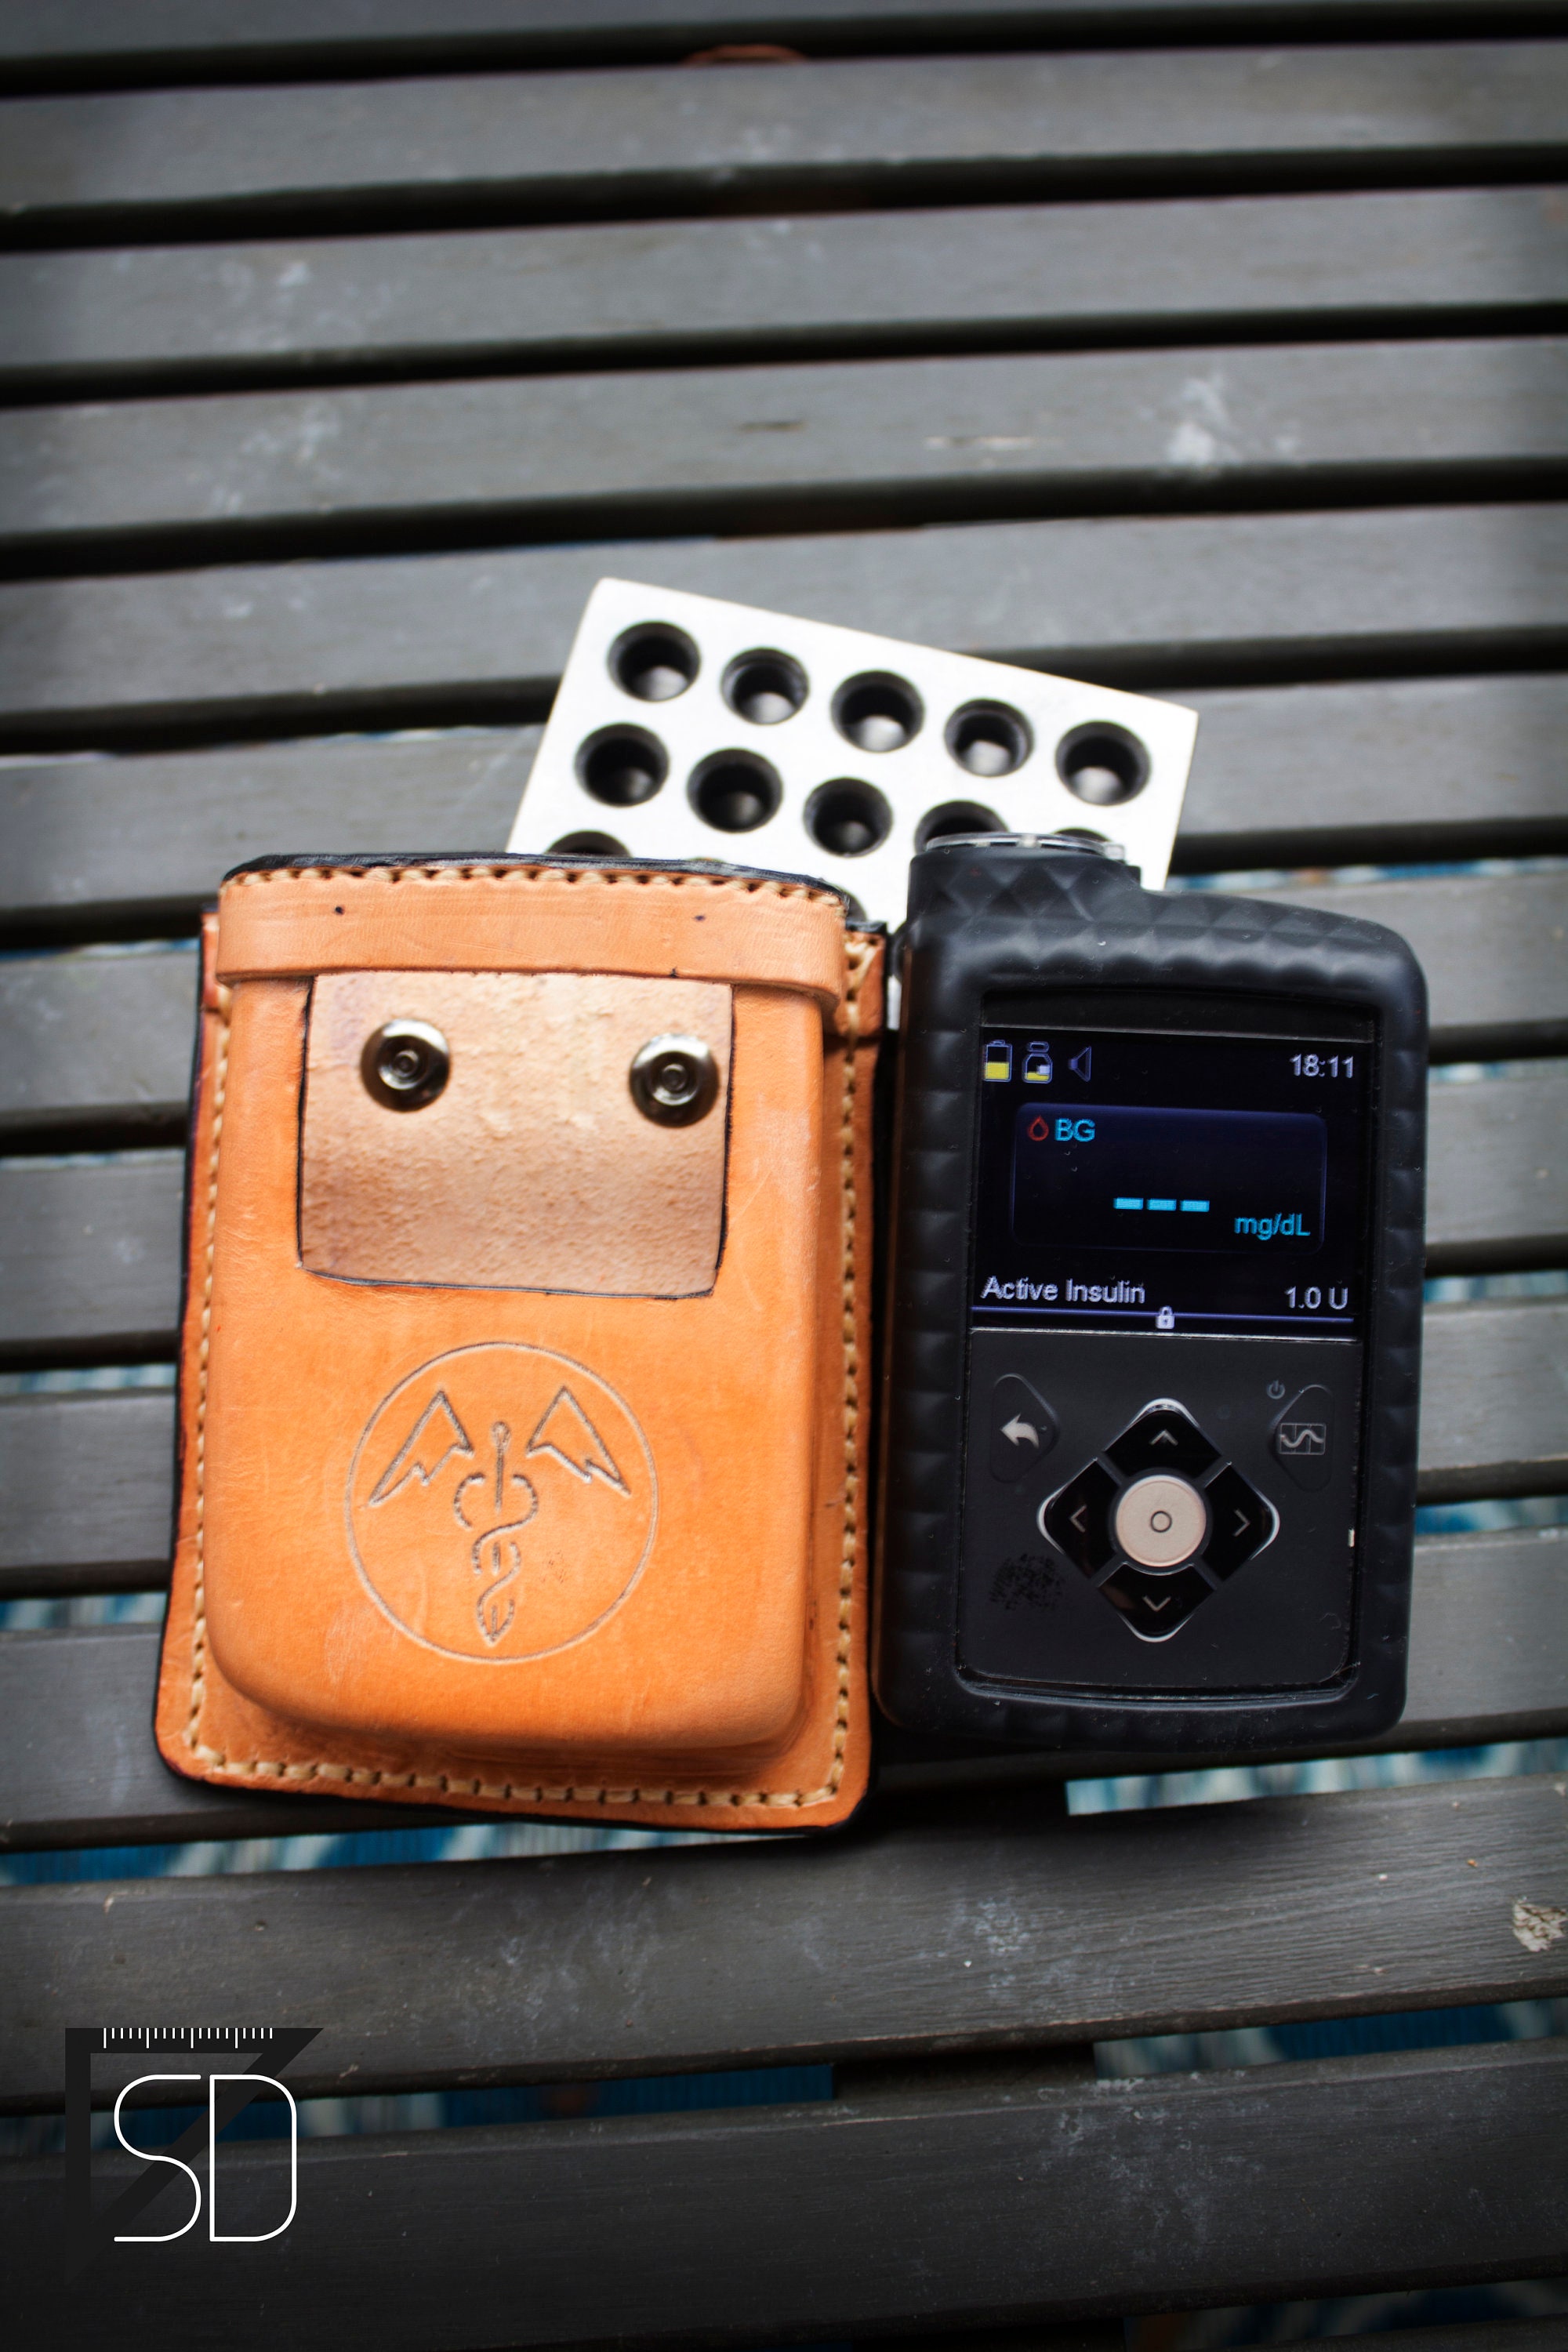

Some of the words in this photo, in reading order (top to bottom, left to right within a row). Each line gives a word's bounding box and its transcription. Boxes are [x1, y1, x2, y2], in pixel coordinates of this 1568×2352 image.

[1289, 1053, 1355, 1079] 18:11
[1054, 1118, 1096, 1142] BG
[1234, 1213, 1311, 1240] mg/dL
[980, 1276, 1058, 1301] Active
[1065, 1279, 1145, 1305] Insulin
[1284, 1287, 1322, 1310] 1.0
[1328, 1287, 1348, 1310] U
